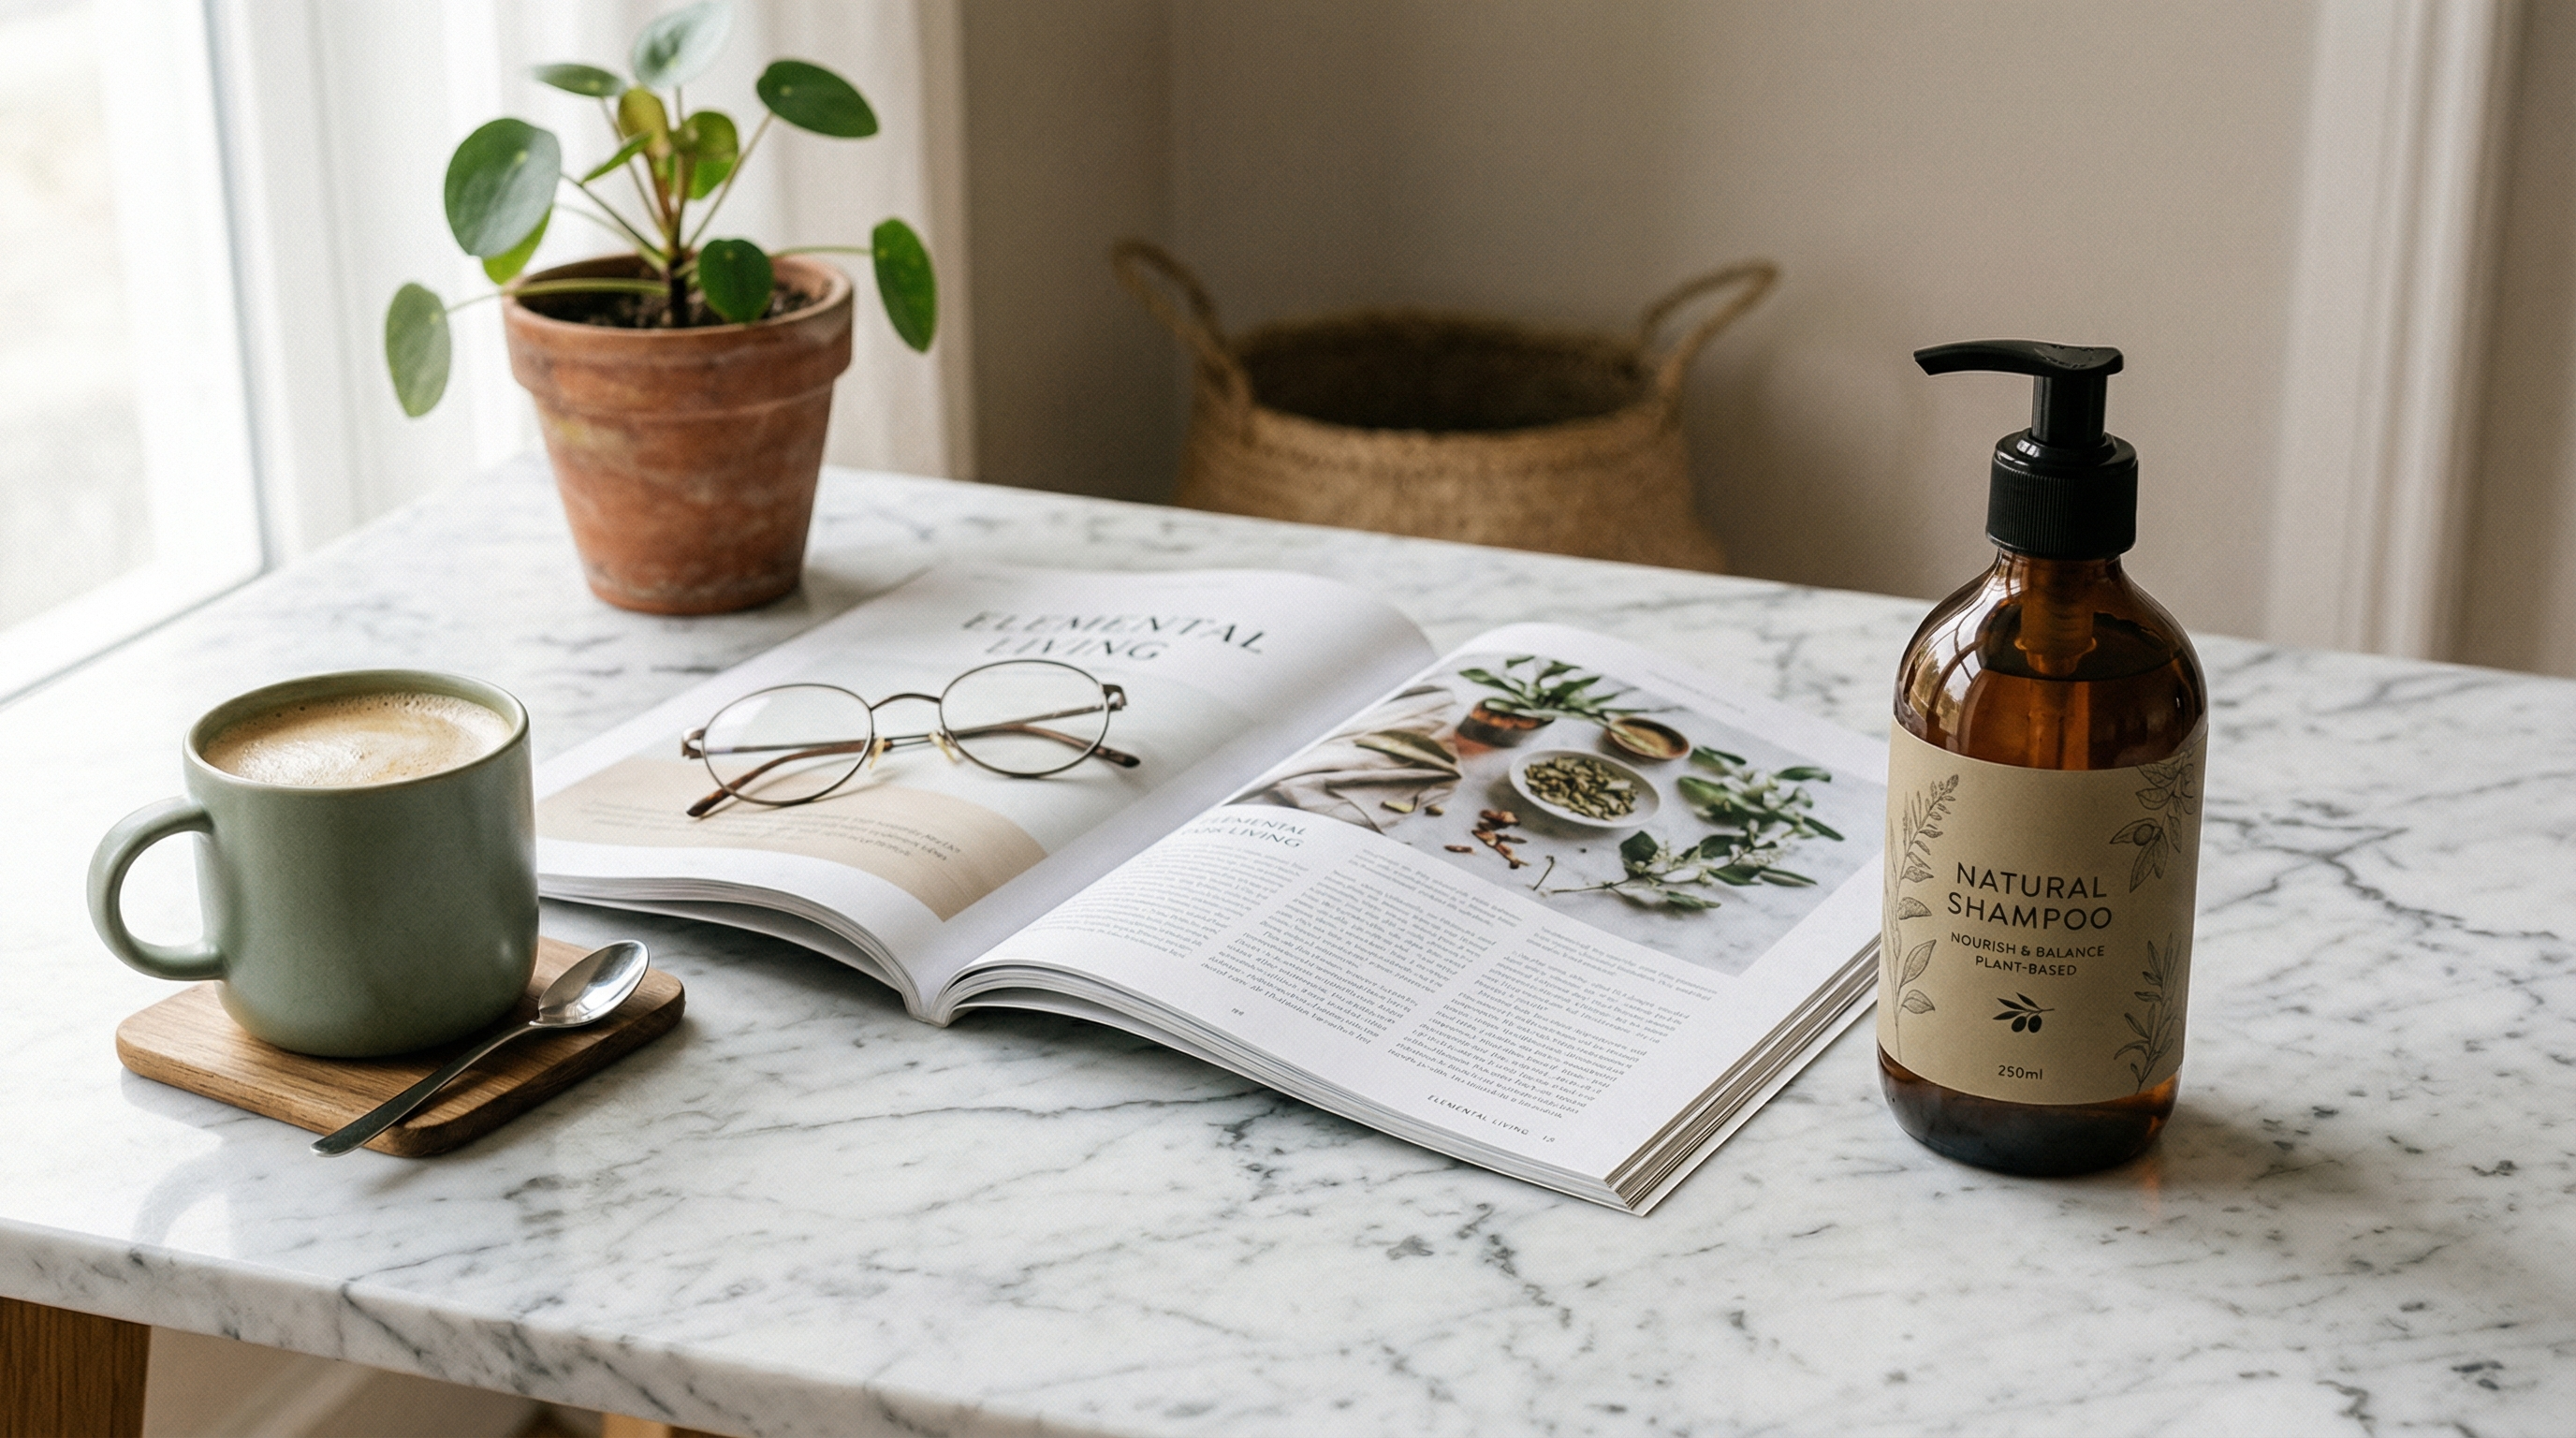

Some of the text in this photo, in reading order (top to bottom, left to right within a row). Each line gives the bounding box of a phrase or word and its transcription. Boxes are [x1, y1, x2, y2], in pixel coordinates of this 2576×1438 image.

[962, 610, 1265, 654] ELEMENTAL
[985, 638, 1170, 661] LIVING
[1228, 827, 1305, 848] LIVING
[1956, 861, 2108, 900] NATURAL
[1947, 891, 2113, 931] SHAMPOO
[1951, 932, 2105, 959] NOURISH & BALANCE
[1975, 955, 2077, 976] PLANT-BASED
[1998, 1064, 2043, 1080] 250ml
[1427, 1094, 1488, 1122] ELEMENTAL
[1491, 1118, 1530, 1136] LIVING
